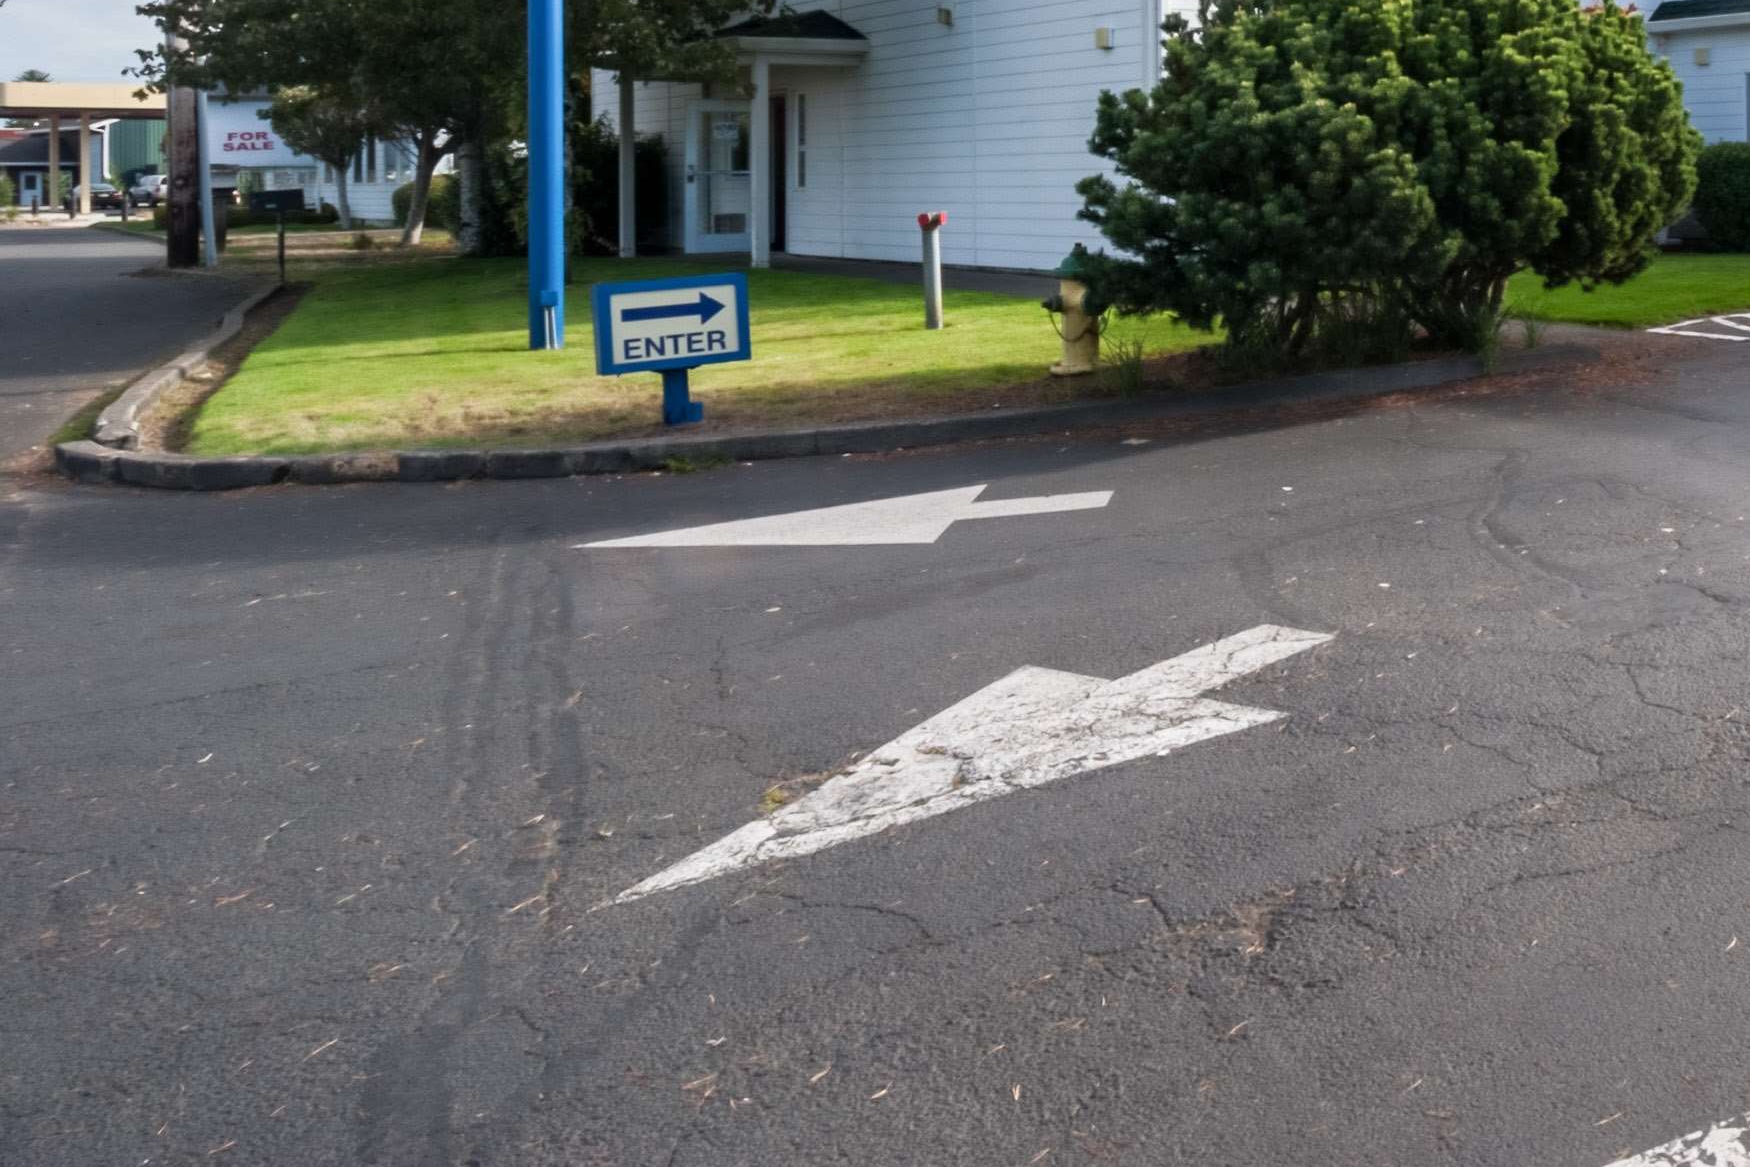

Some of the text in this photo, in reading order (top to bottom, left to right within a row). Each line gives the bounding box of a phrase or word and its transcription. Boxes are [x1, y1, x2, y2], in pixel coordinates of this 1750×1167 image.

[226, 131, 269, 141] FOR
[223, 141, 275, 152] SALE
[623, 330, 727, 360] ENTER
